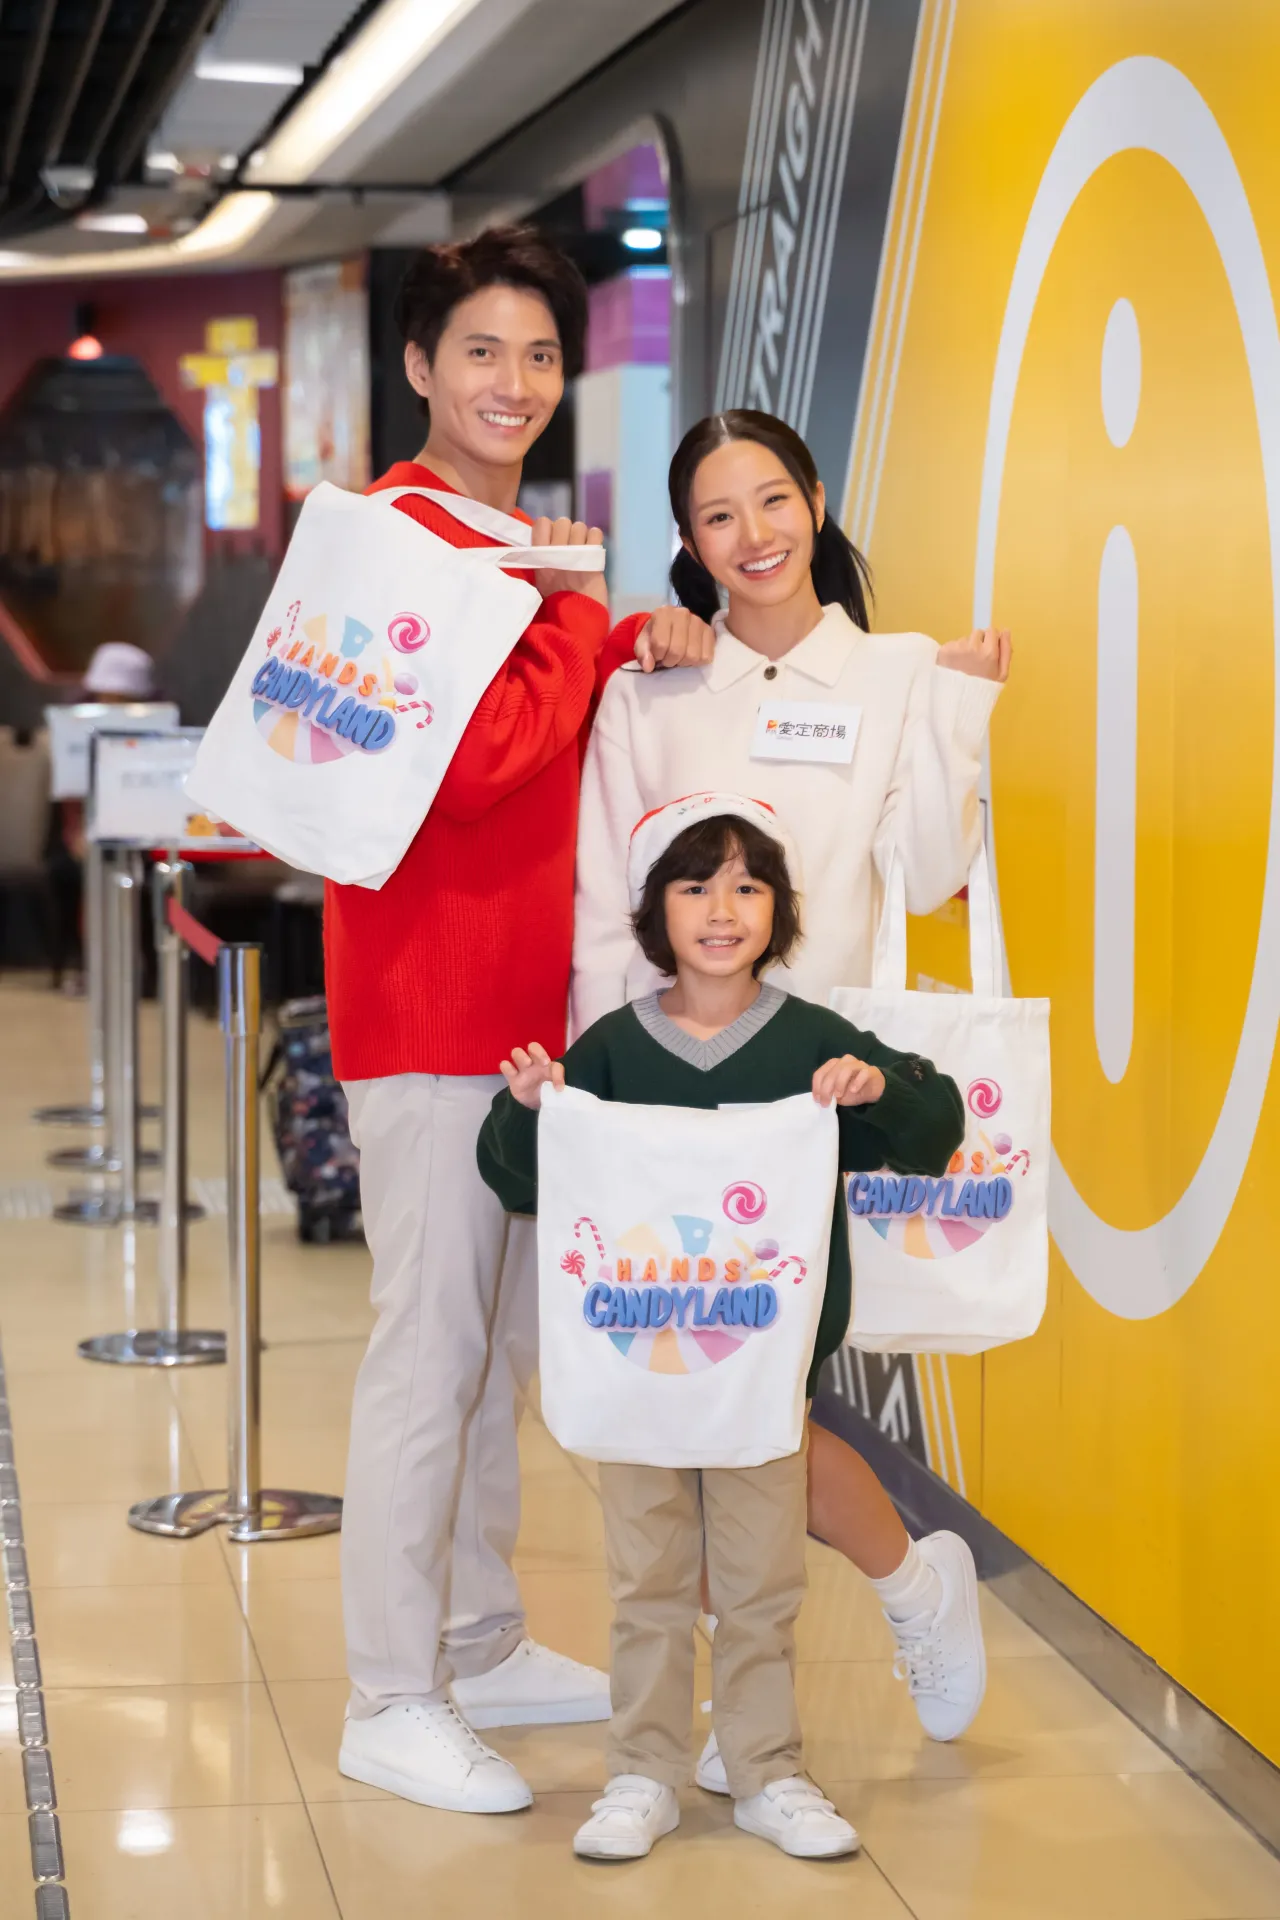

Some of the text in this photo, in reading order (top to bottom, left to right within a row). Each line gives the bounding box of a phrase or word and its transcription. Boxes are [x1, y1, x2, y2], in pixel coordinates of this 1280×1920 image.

[751, 0, 831, 416] TRAIGH
[286, 640, 378, 697] HANDS
[251, 656, 396, 751] CANDYLAND
[778, 720, 846, 740] 愛定商場
[847, 1173, 1013, 1219] CANDYLAND
[616, 1257, 742, 1283] HANDS
[582, 1281, 778, 1329] CANDYLAND
